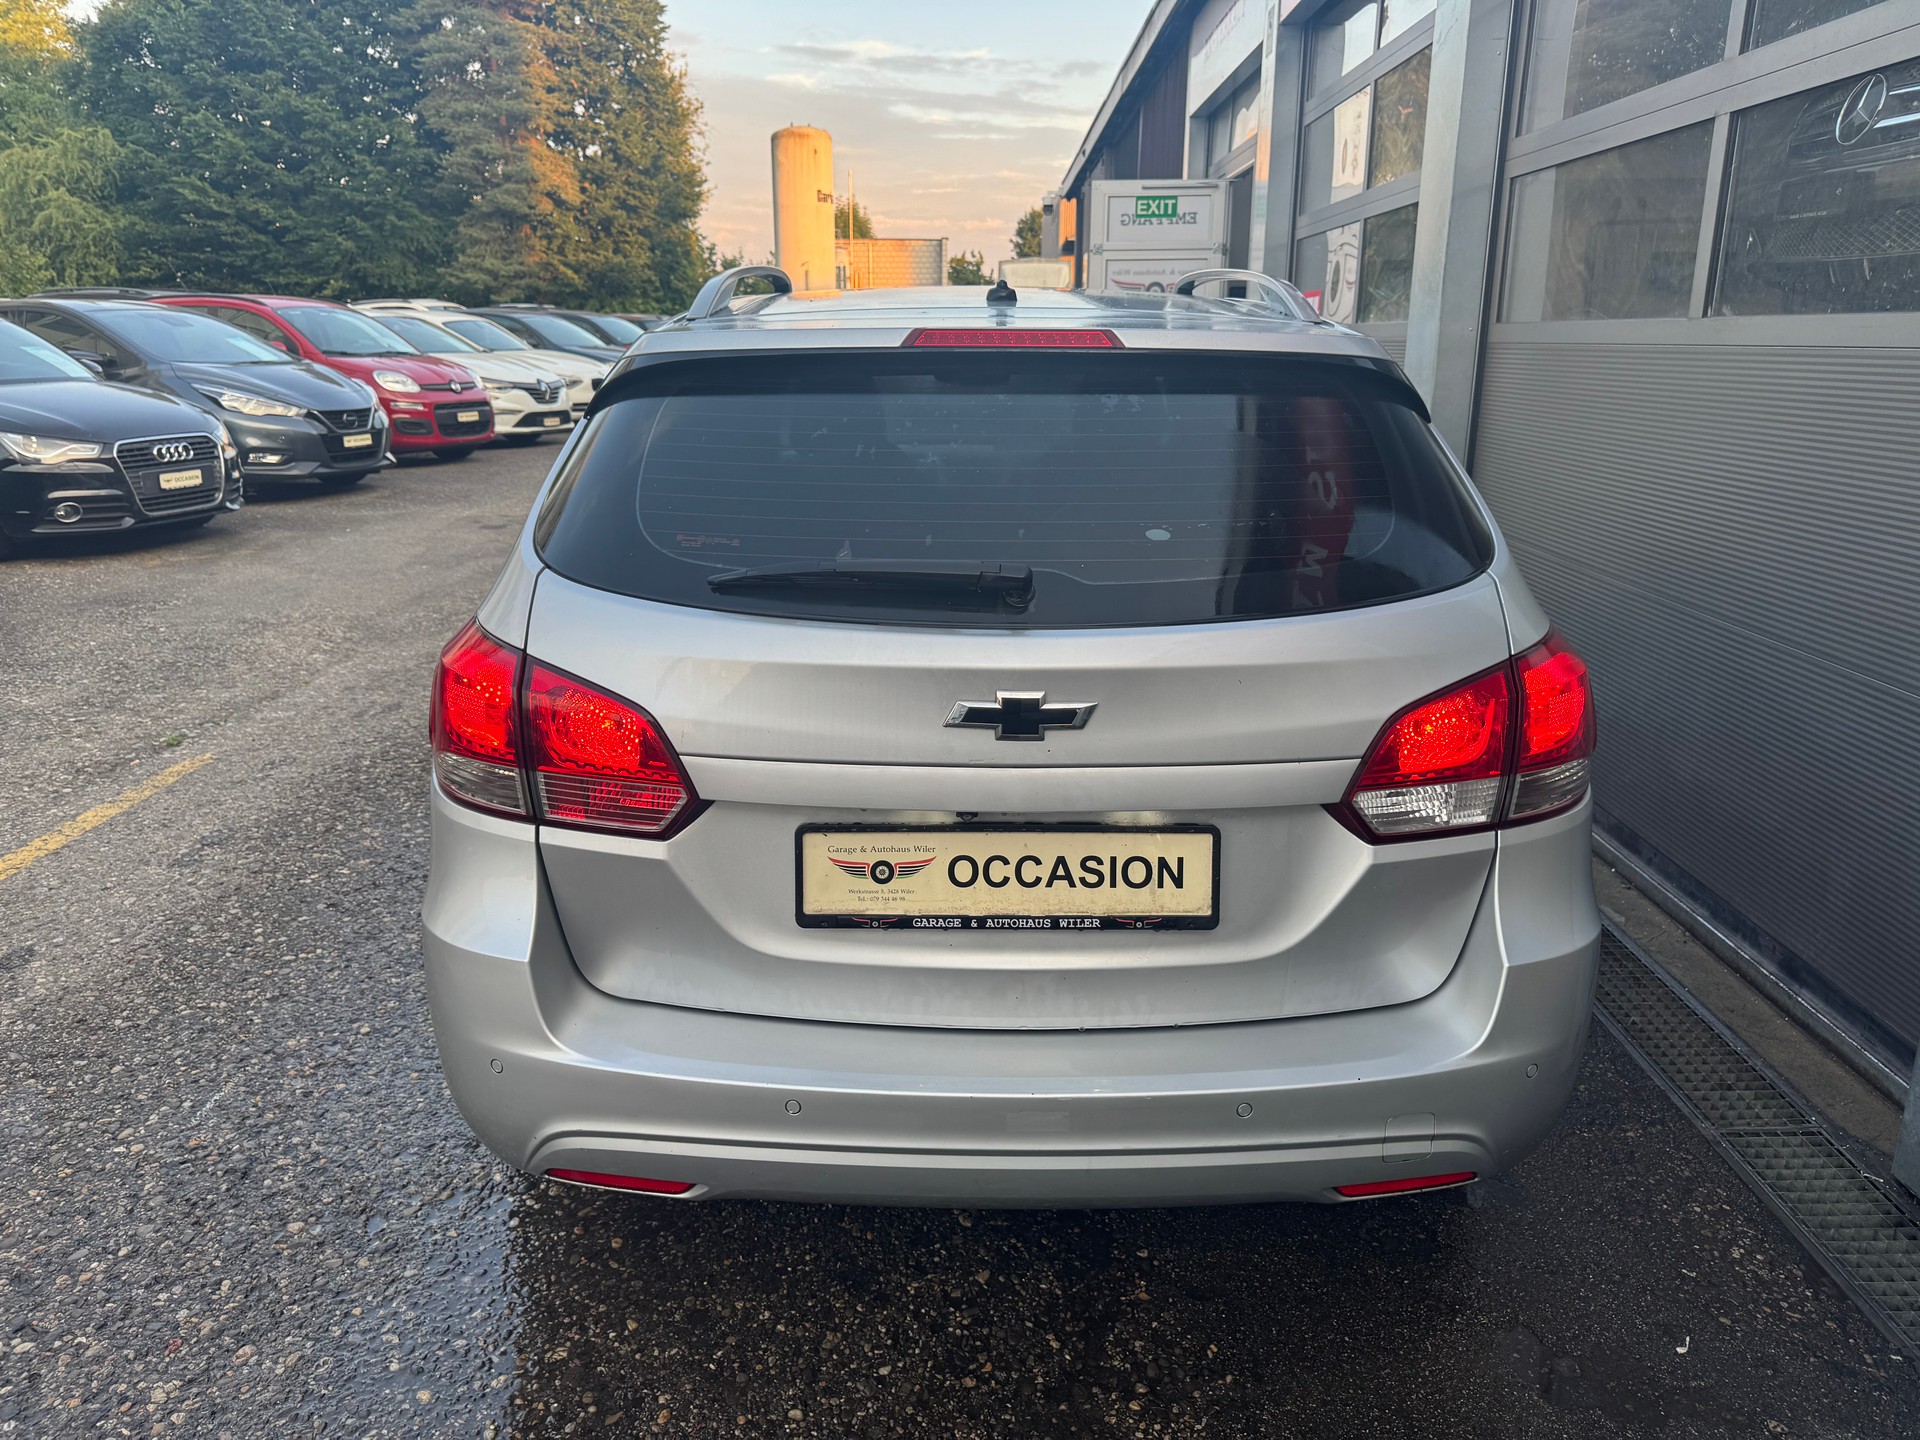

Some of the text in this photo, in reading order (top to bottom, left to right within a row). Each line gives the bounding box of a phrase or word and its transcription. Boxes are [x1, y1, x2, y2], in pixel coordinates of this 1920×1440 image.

[1136, 199, 1176, 215] EXIT
[827, 845, 858, 855] Garage
[870, 845, 911, 853] Autohaus
[913, 845, 936, 853] Wiler
[947, 854, 1185, 889] OCCASION
[912, 918, 1101, 928] GARAGE & AUTOHAUS WILER
